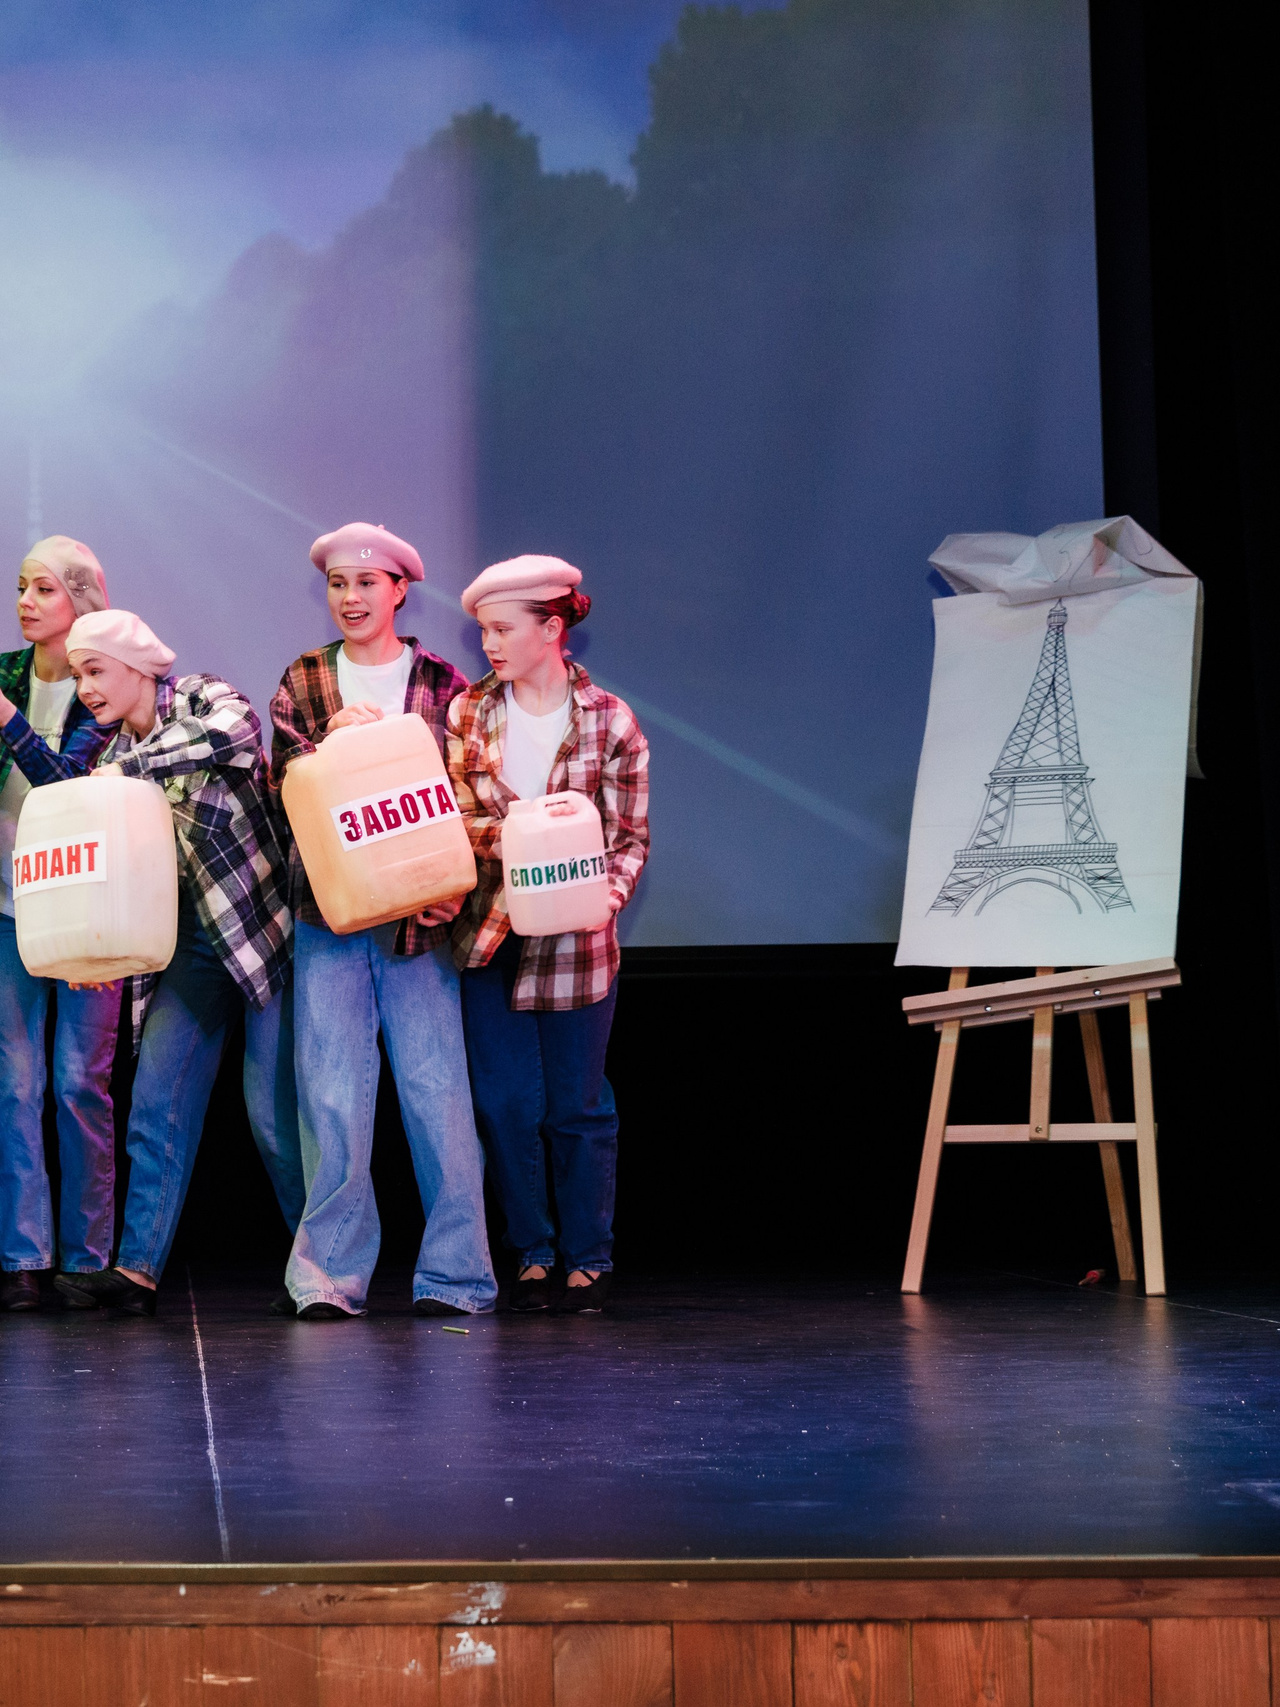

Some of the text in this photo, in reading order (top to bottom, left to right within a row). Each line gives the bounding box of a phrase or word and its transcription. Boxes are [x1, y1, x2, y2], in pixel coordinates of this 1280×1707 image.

[339, 783, 455, 842] ЗАБОТА
[14, 841, 99, 888] ТАЛАНТ
[510, 855, 606, 888] СПОКОЙСТВ
